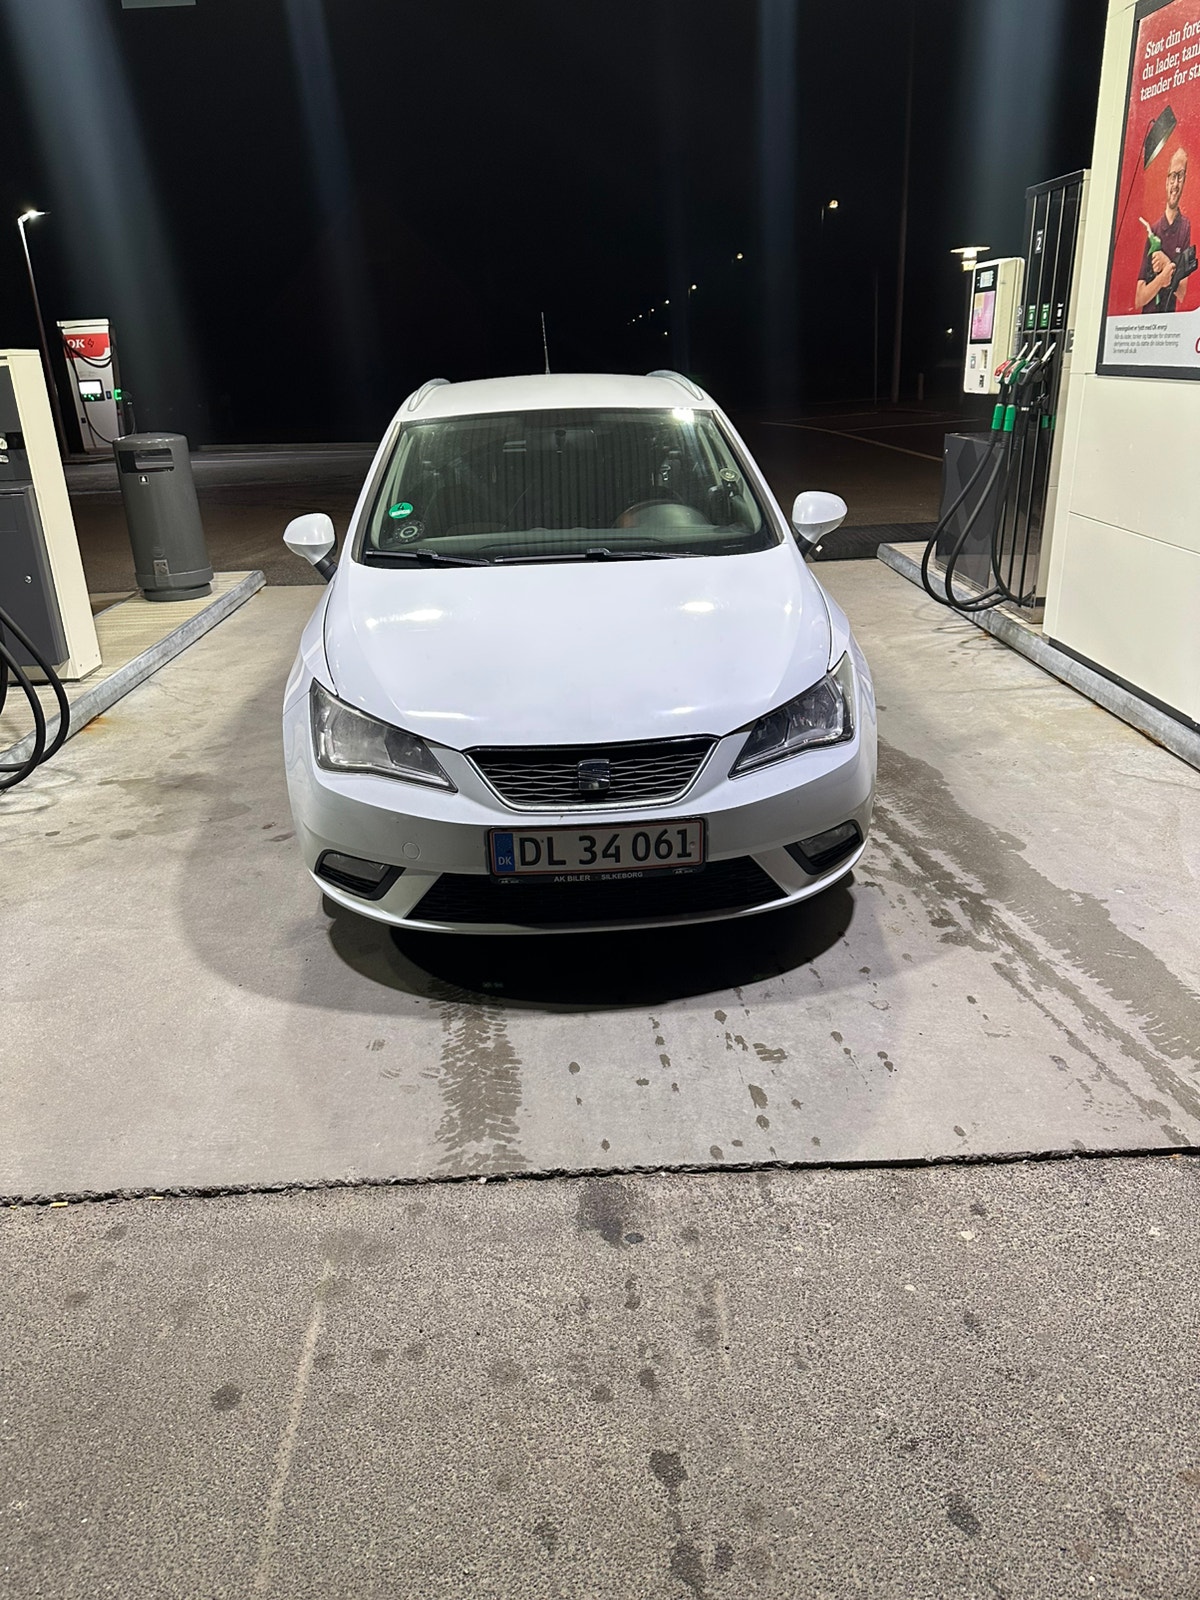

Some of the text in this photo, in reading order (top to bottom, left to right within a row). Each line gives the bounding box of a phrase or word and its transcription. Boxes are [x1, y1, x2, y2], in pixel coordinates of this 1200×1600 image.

[1142, 38, 1200, 80] du lader, tan
[1145, 37, 1165, 59] Støt
[1166, 28, 1180, 49] din
[1140, 76, 1172, 101] tænder
[1173, 69, 1188, 88] for
[66, 339, 85, 348] OK
[498, 856, 512, 866] DK
[519, 828, 692, 866] DL 34 061
[567, 874, 591, 882] BILER
[601, 872, 643, 880] SILKEBORG
